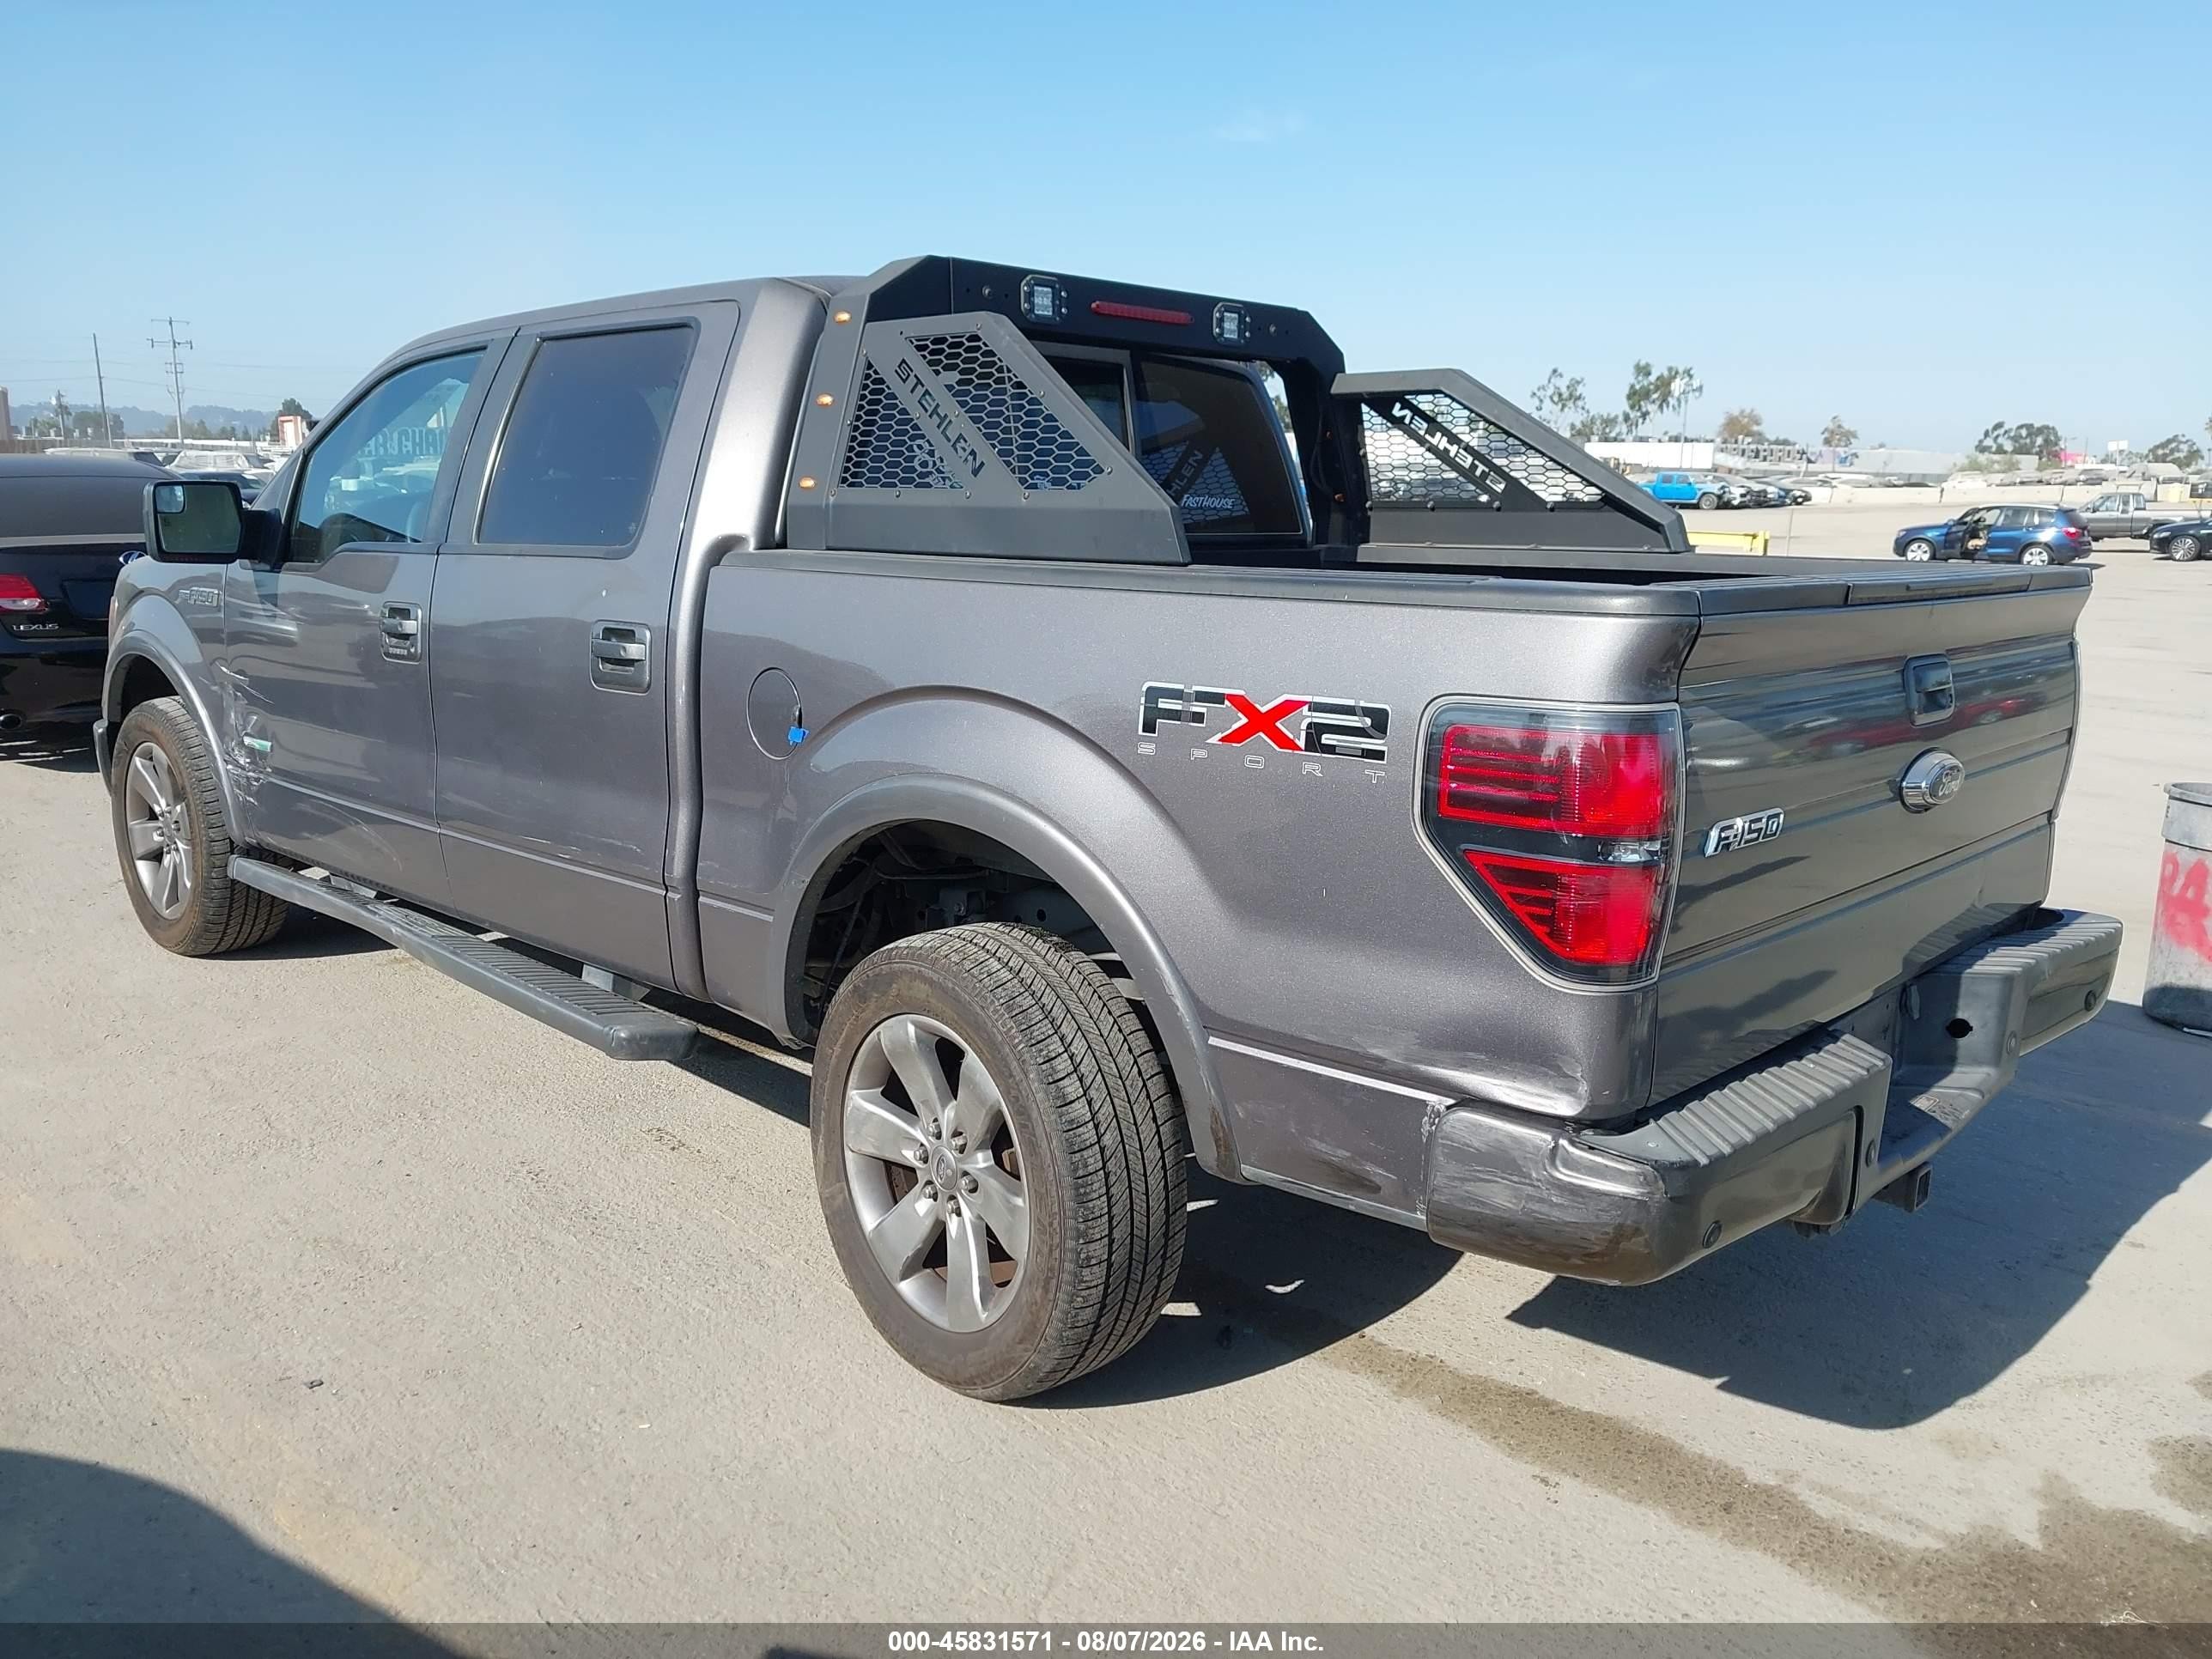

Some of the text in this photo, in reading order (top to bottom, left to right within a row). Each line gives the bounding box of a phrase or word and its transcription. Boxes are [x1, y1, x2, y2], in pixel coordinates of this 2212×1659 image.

[894, 357, 986, 478] STEHLEN
[1181, 494, 1237, 509] FASTHOUSE
[1138, 681, 1392, 764] FX2
[1137, 741, 1385, 784] SPORT
